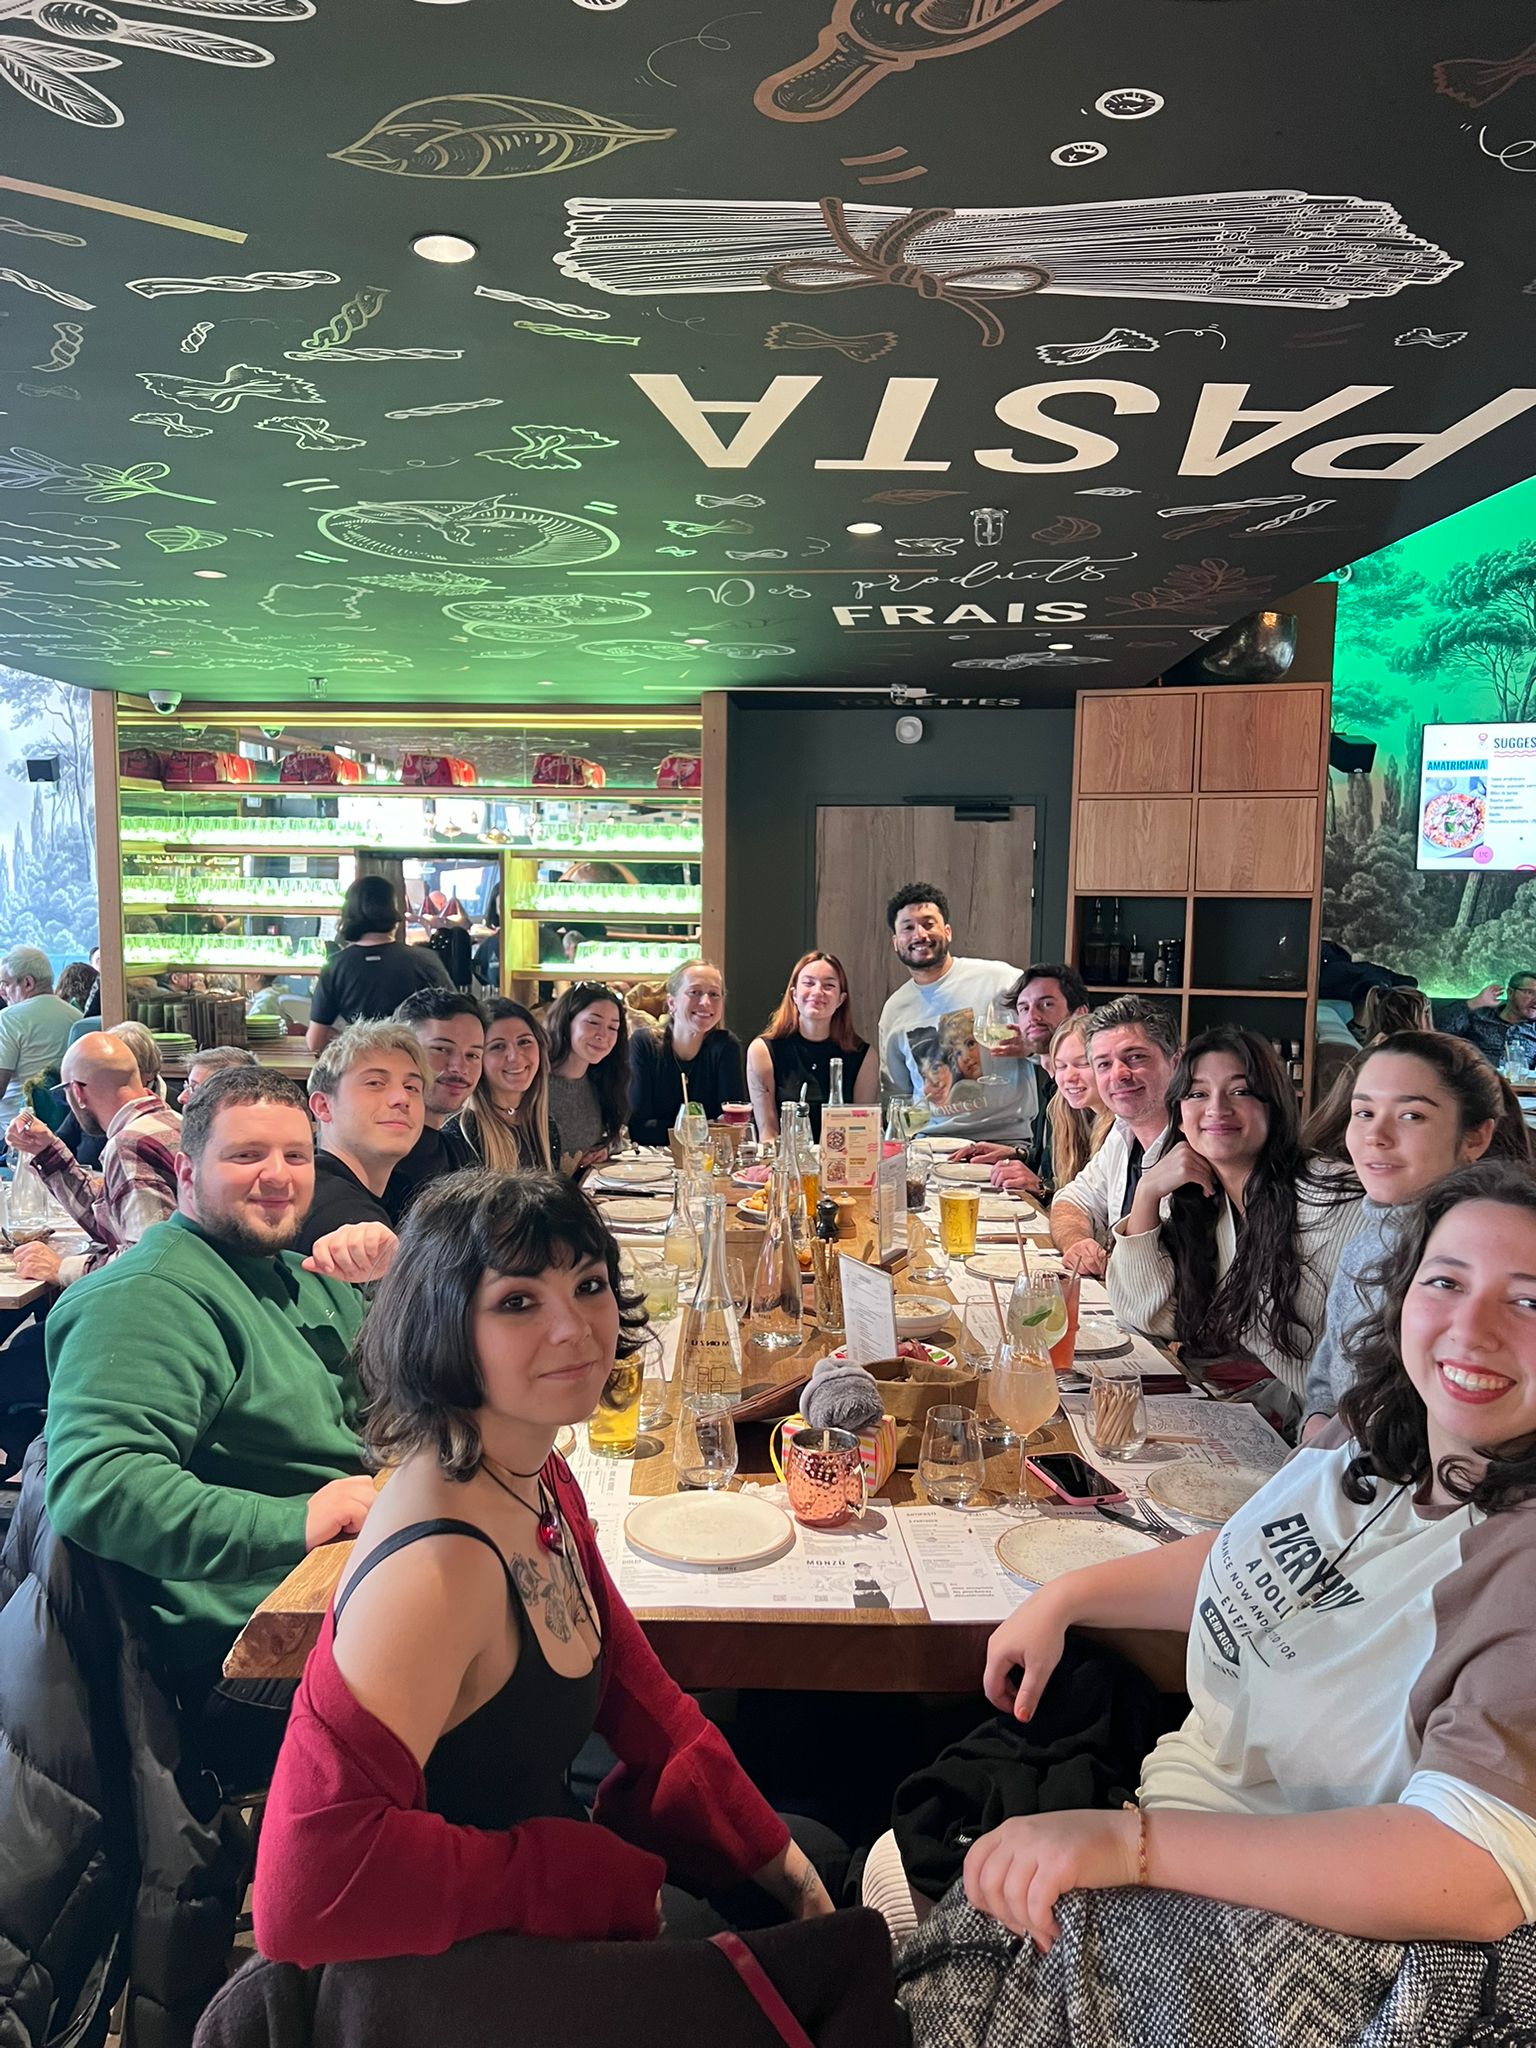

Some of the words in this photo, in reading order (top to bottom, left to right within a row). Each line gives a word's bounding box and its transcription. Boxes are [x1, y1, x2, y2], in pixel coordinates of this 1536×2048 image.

[629, 373, 1536, 480] PASTA
[852, 551, 1139, 600] produits
[125, 598, 211, 607] ROMA
[831, 602, 1088, 626] FRAIS
[1427, 760, 1487, 771] AMATRICIANA
[1245, 1558, 1263, 1573] A
[1230, 1572, 1253, 1601] NOW
[1249, 1604, 1269, 1627] AND
[1204, 1607, 1223, 1632] SEND
